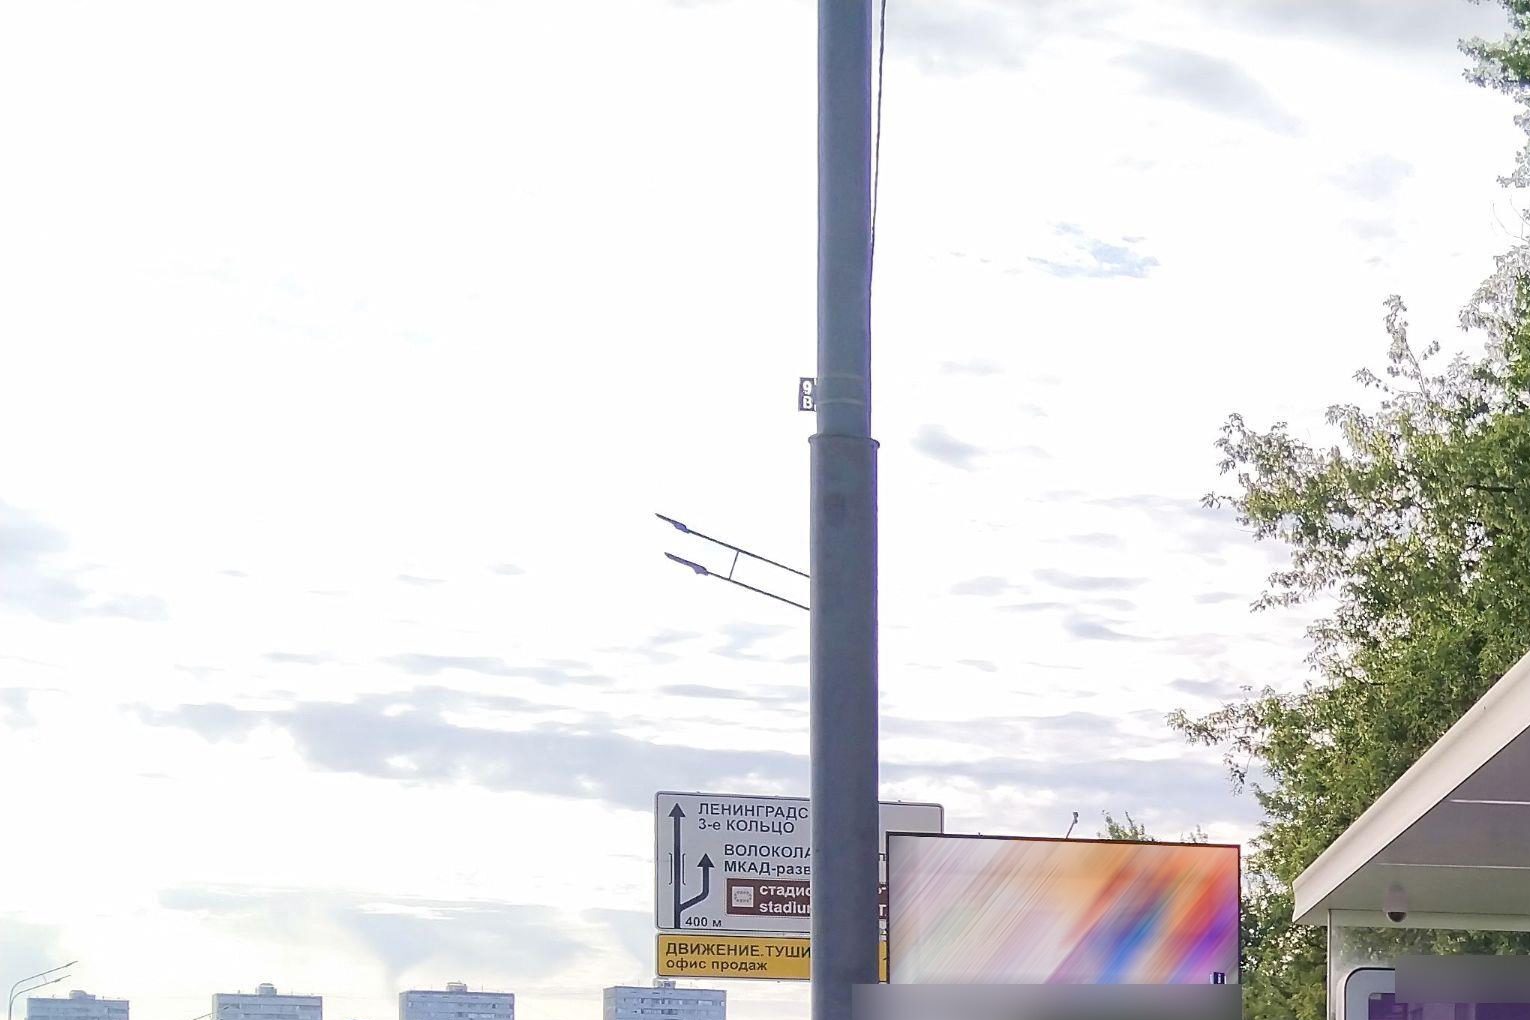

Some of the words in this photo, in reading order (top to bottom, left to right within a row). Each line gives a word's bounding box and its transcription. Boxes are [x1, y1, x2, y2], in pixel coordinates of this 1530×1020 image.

[698, 802, 809, 820] ЛЕНИНГРАДС
[698, 818, 721, 830] 3-е
[726, 819, 795, 835] КОЛЬЦО
[759, 900, 811, 914] stadiu
[685, 916, 708, 927] 400
[712, 919, 722, 928] м
[666, 958, 707, 971] офис
[711, 960, 768, 972] продаж
